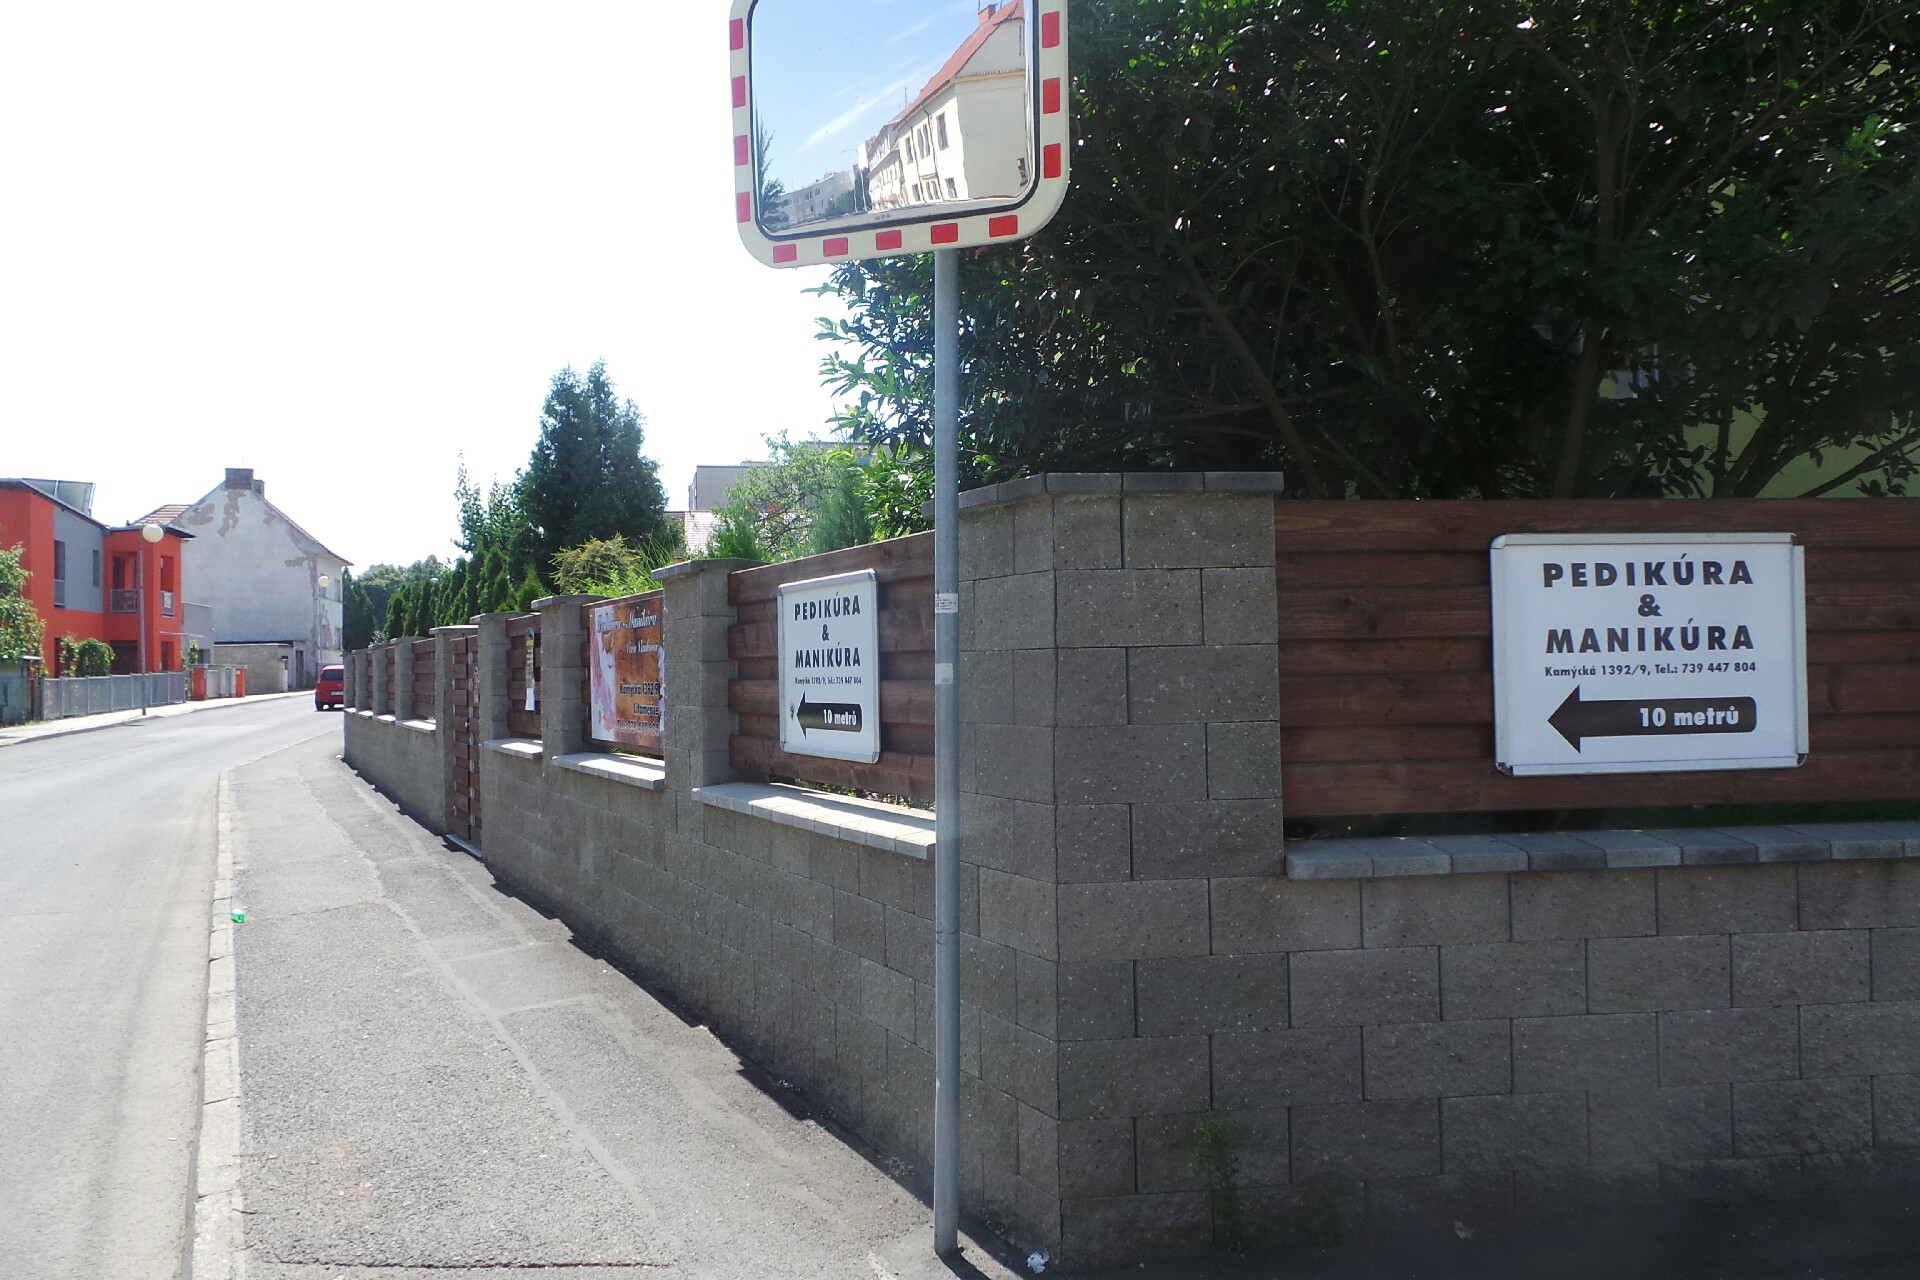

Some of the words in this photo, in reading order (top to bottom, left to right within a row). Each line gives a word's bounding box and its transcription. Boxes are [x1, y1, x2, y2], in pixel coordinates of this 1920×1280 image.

[1543, 552, 1754, 588] PEDIKÚRA
[794, 591, 861, 621] PEDIKÚRA
[1637, 593, 1663, 617] &
[821, 623, 830, 642] &
[1545, 618, 1754, 654] MANIKÚRA
[795, 642, 861, 669] MANIKÚRA
[1544, 665, 1596, 679] Kamýcká
[1601, 663, 1651, 677] 1392/9,
[1654, 662, 1679, 675] Tel.:
[1681, 662, 1704, 674] 739
[1707, 661, 1730, 673] 447
[1734, 661, 1757, 673] 804
[823, 708, 833, 725] 10
[833, 710, 857, 727] metrů
[1639, 706, 1667, 728] 10
[1674, 705, 1739, 727] metrů
